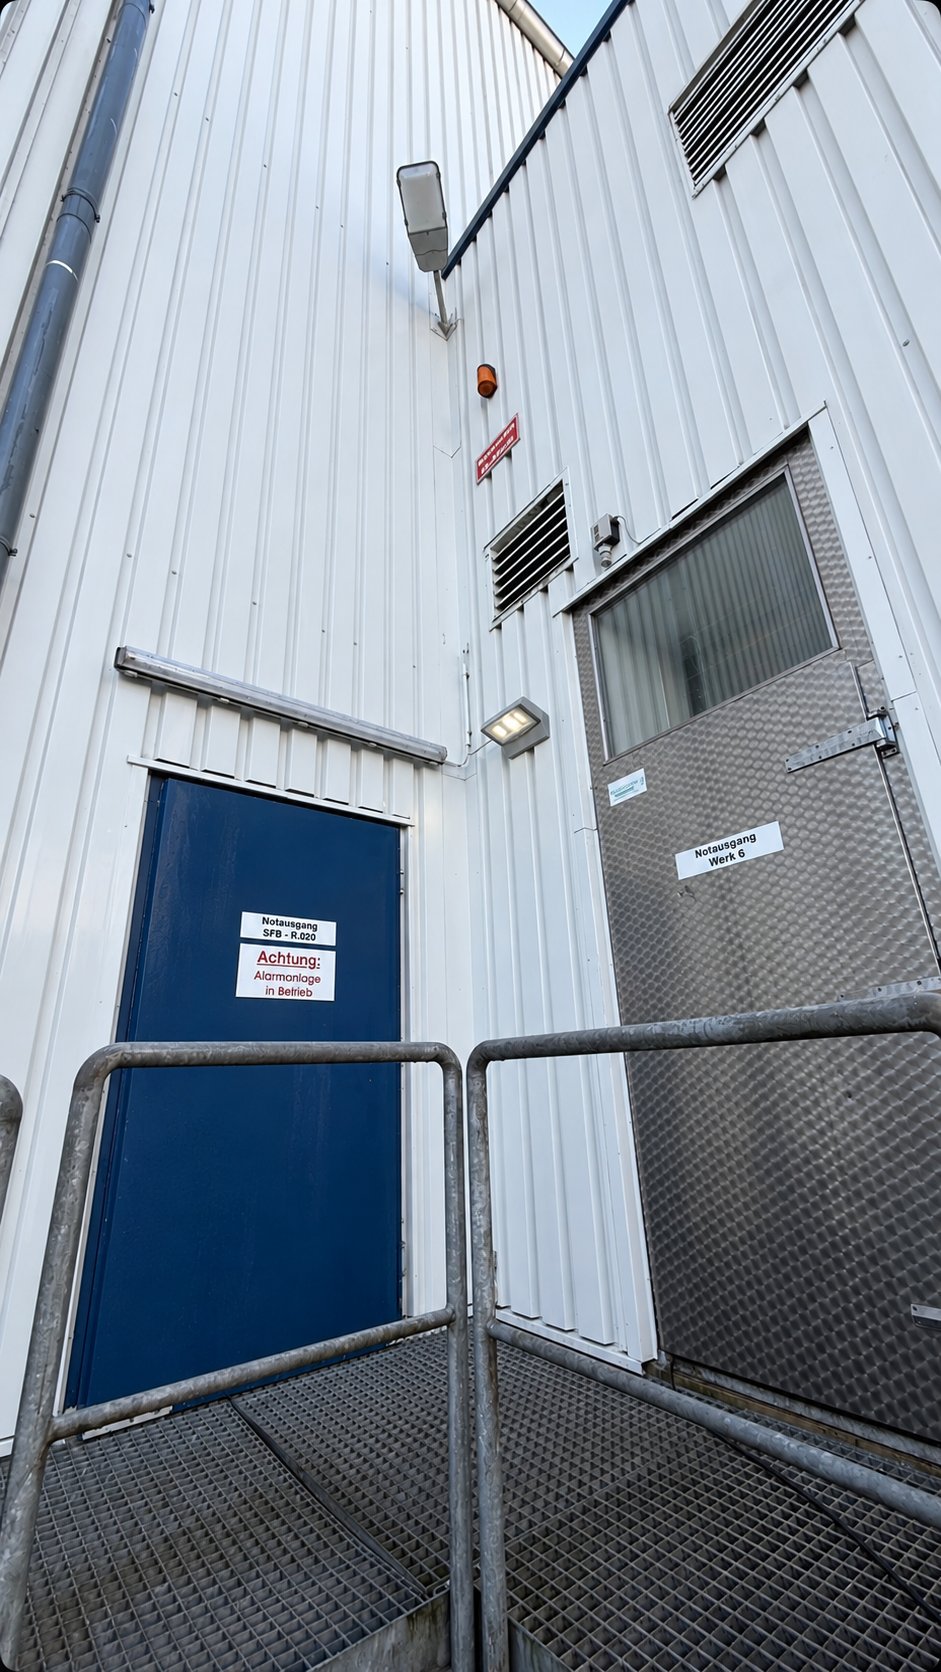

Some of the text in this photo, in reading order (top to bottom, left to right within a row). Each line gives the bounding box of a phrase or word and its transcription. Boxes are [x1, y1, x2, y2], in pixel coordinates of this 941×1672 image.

[695, 834, 757, 858] Notausgang
[708, 849, 746, 867] Werk 6
[262, 916, 318, 932] Notausgang
[263, 928, 282, 938] SFB
[291, 931, 316, 941] R.020
[257, 950, 321, 970] Achtung:
[265, 985, 313, 997] in Betrieb
